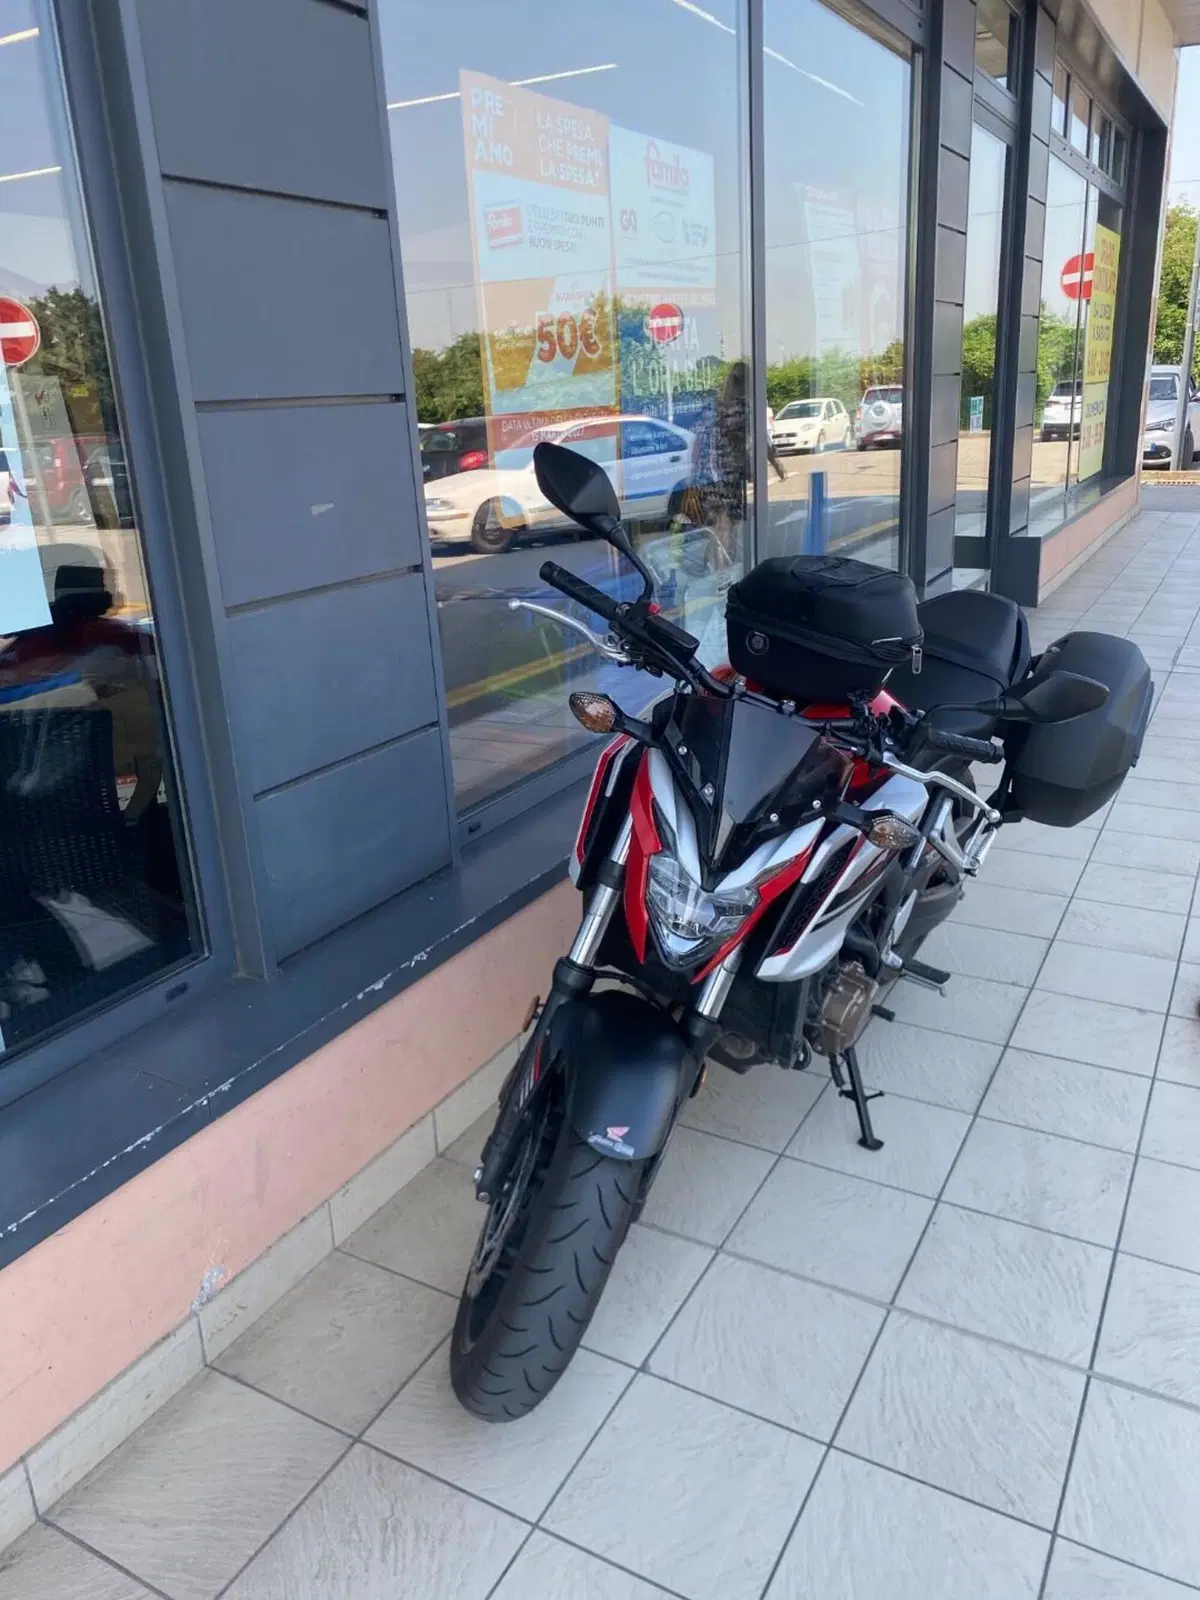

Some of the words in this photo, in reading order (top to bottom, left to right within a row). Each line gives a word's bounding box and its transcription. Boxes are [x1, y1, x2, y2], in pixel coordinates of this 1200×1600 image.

[470, 87, 505, 116] PRE
[471, 114, 493, 137] MI
[536, 307, 602, 364] 50€
[501, 420, 522, 433] DATA
